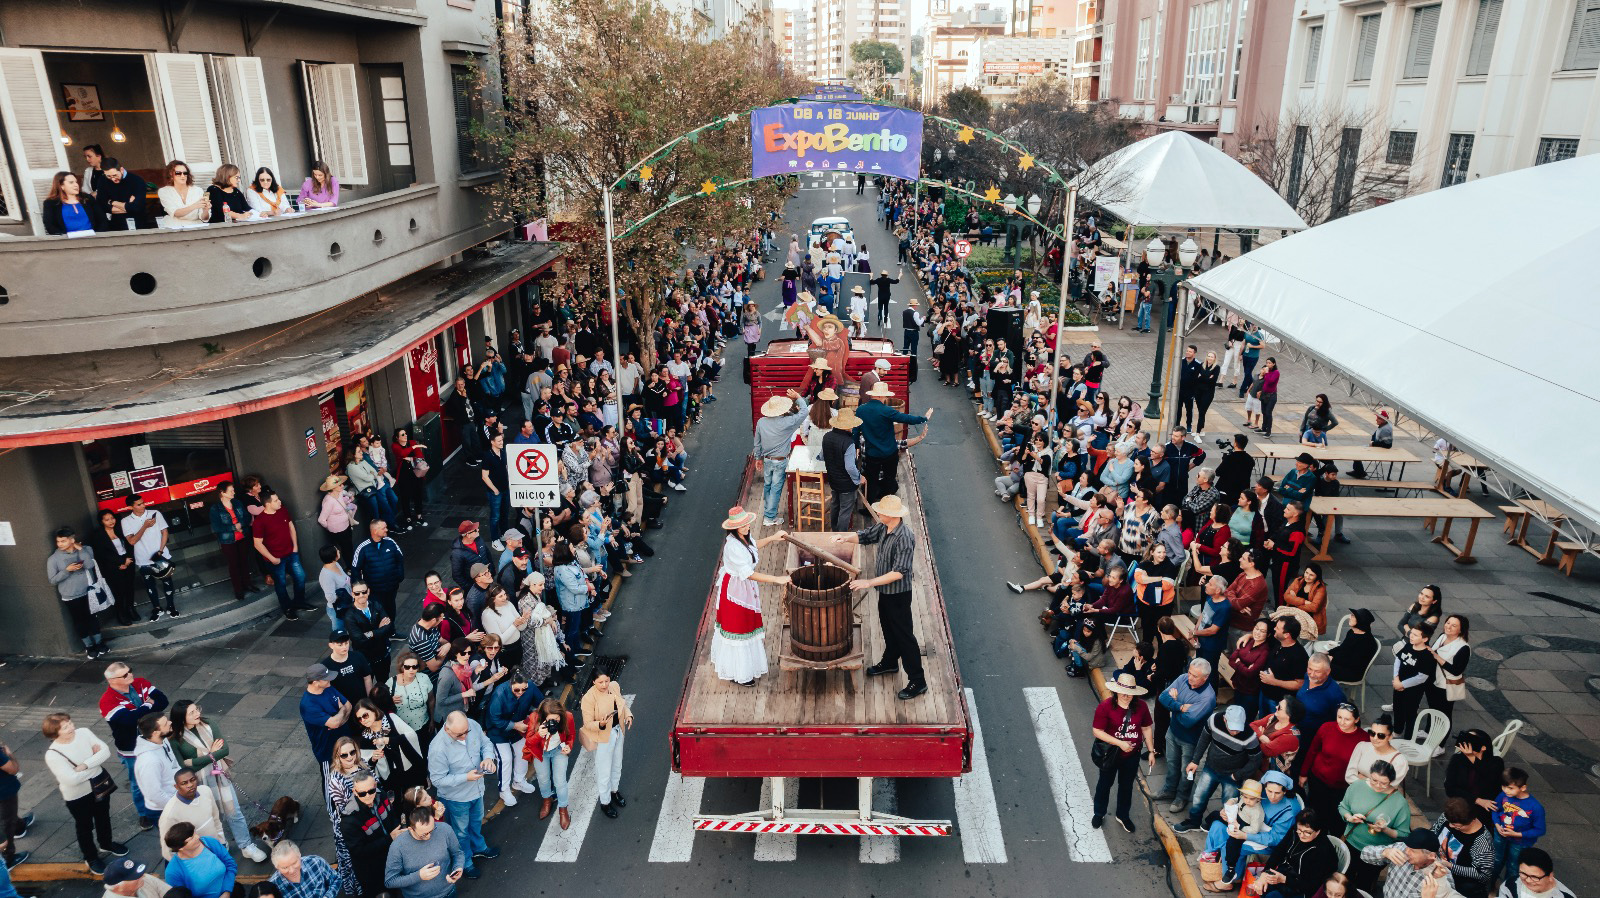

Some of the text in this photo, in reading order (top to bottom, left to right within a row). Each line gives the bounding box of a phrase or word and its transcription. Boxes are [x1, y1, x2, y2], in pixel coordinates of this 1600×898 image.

[794, 108, 880, 120] 08 A 18 JUNHO
[763, 122, 908, 158] ExpoBento
